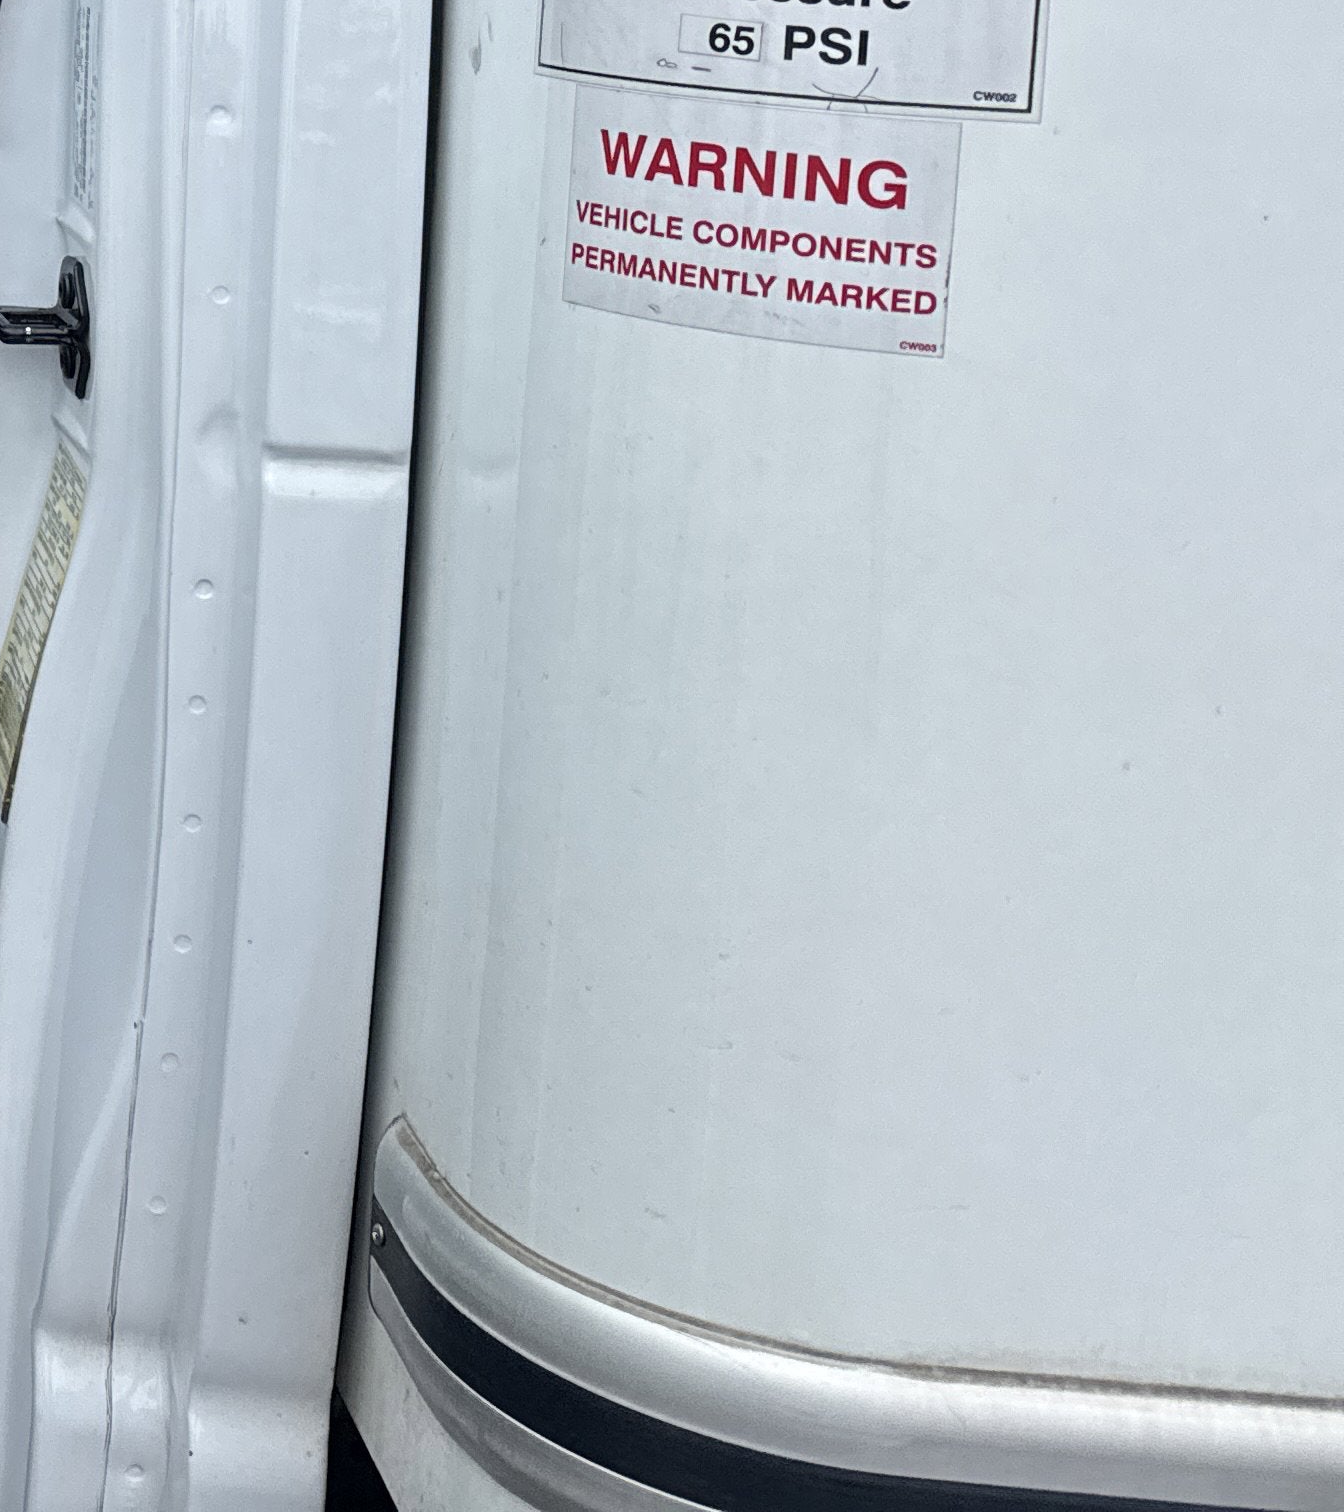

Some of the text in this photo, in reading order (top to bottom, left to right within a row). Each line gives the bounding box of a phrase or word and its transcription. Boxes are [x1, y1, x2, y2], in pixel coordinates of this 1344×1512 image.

[708, 23, 869, 66] 65 PSI
[600, 128, 908, 210] WARNING
[576, 199, 937, 269] VEHICLE COMPONENTS
[571, 243, 937, 315] PERMANENTLY MARKED
